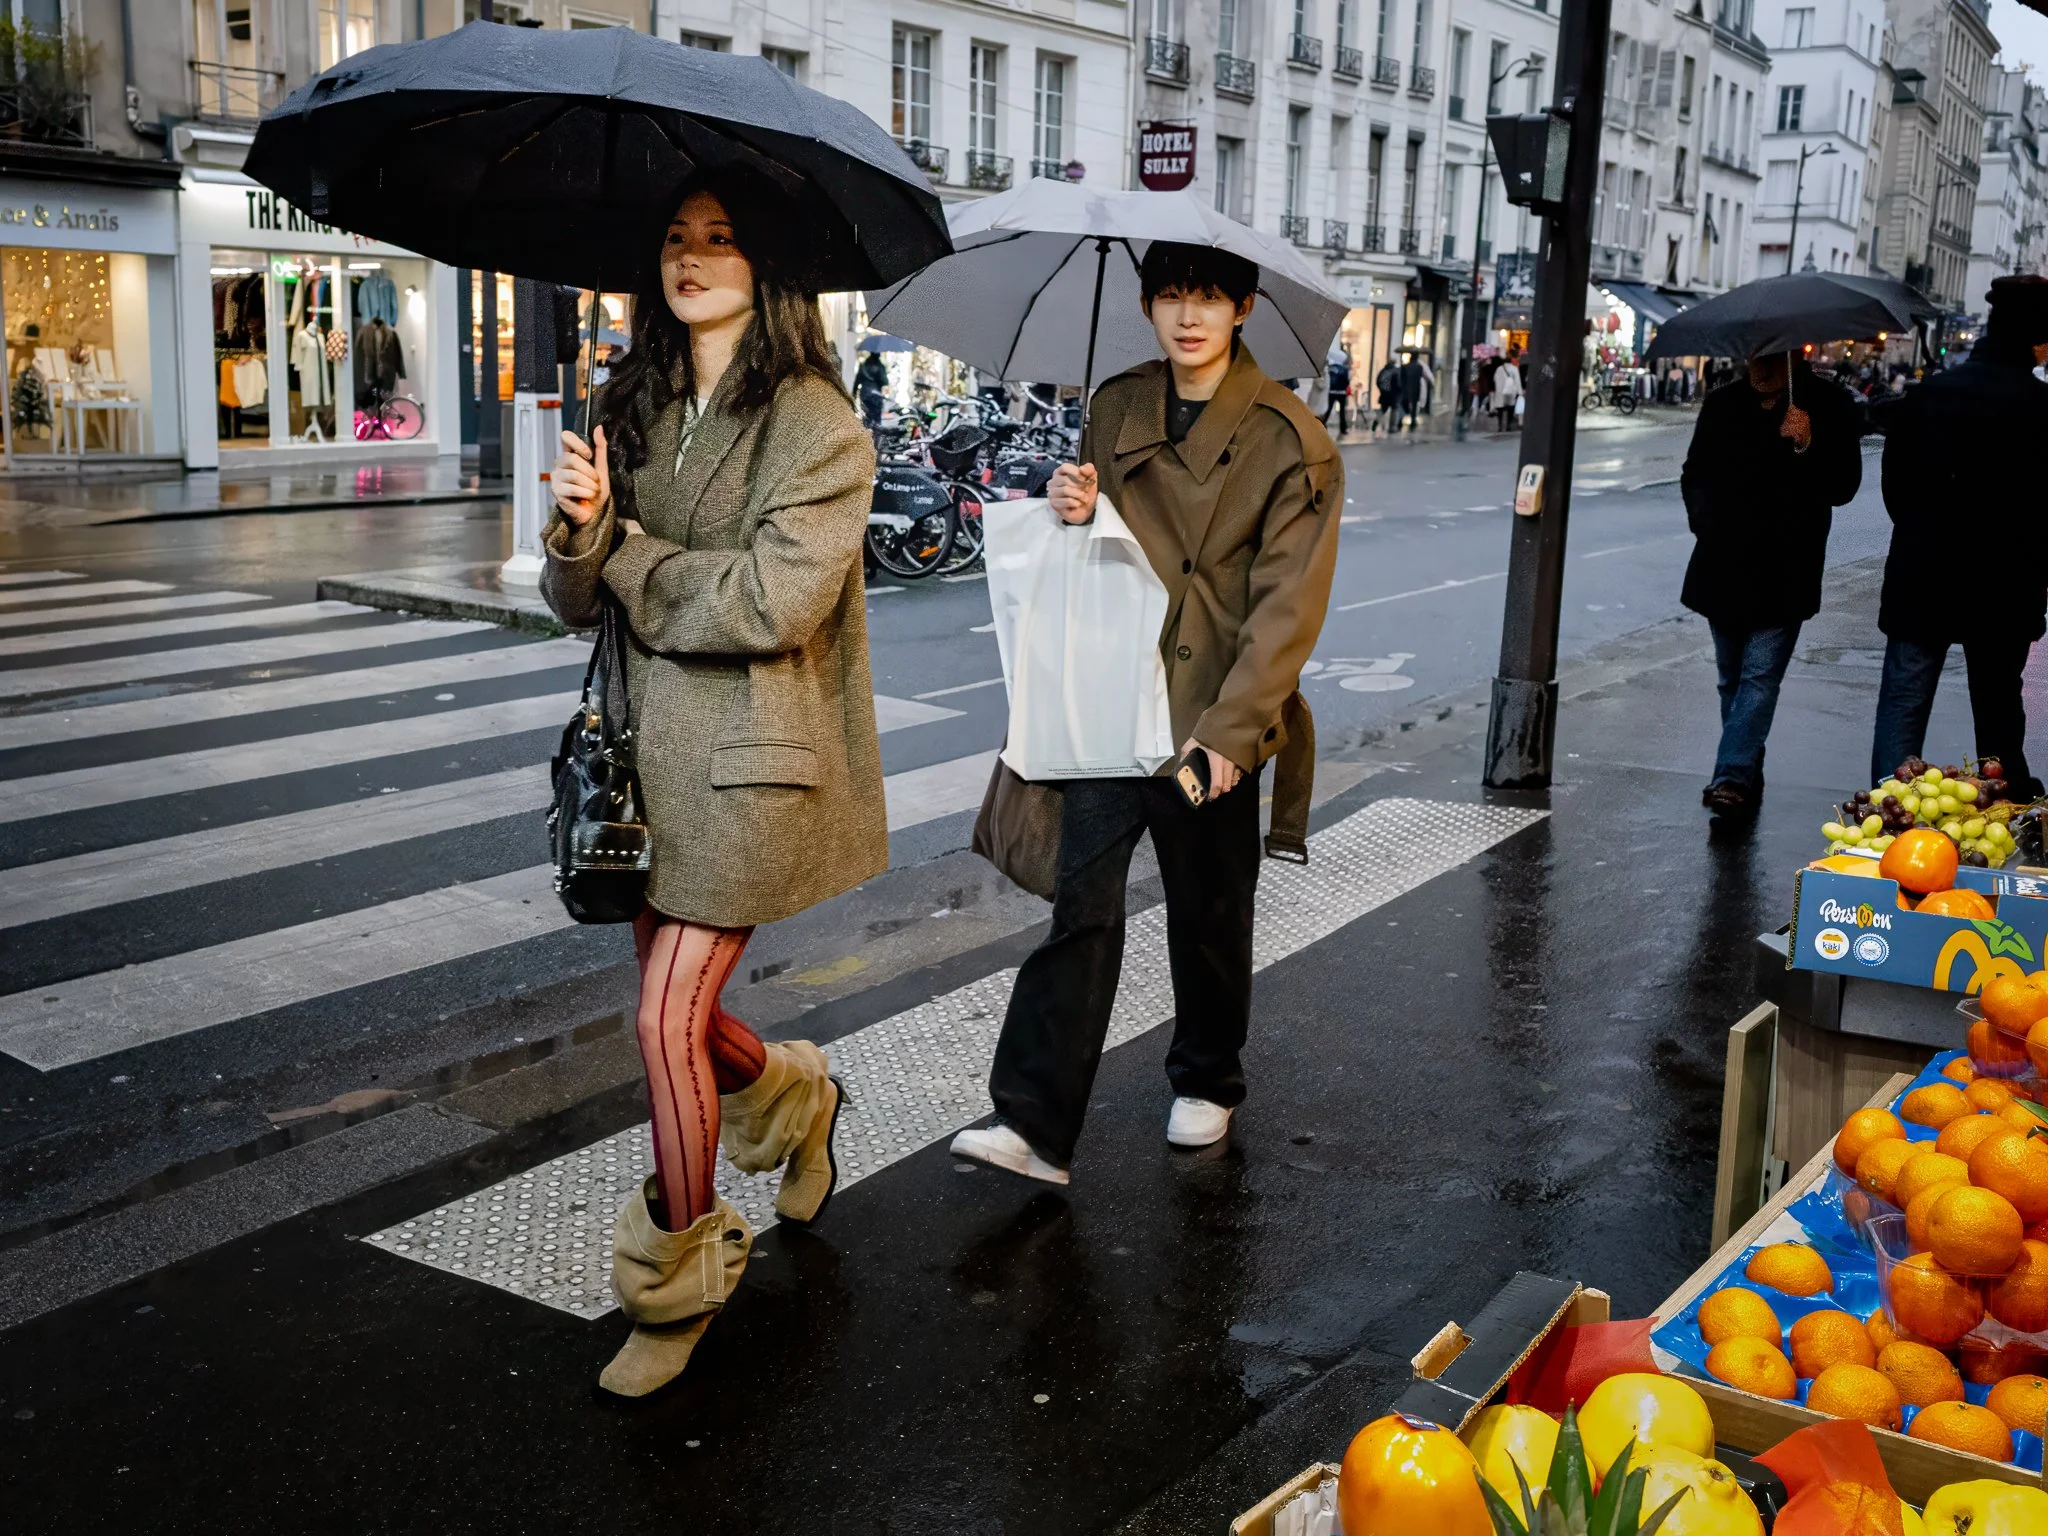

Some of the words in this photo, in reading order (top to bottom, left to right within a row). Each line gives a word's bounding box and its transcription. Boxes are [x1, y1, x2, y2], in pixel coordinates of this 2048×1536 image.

[1142, 132, 1192, 153] HOTEL
[1143, 157, 1189, 174] SULLY
[0, 207, 26, 225] ce
[32, 204, 50, 228] &
[56, 205, 119, 232] Anaïs
[246, 191, 282, 230] THE
